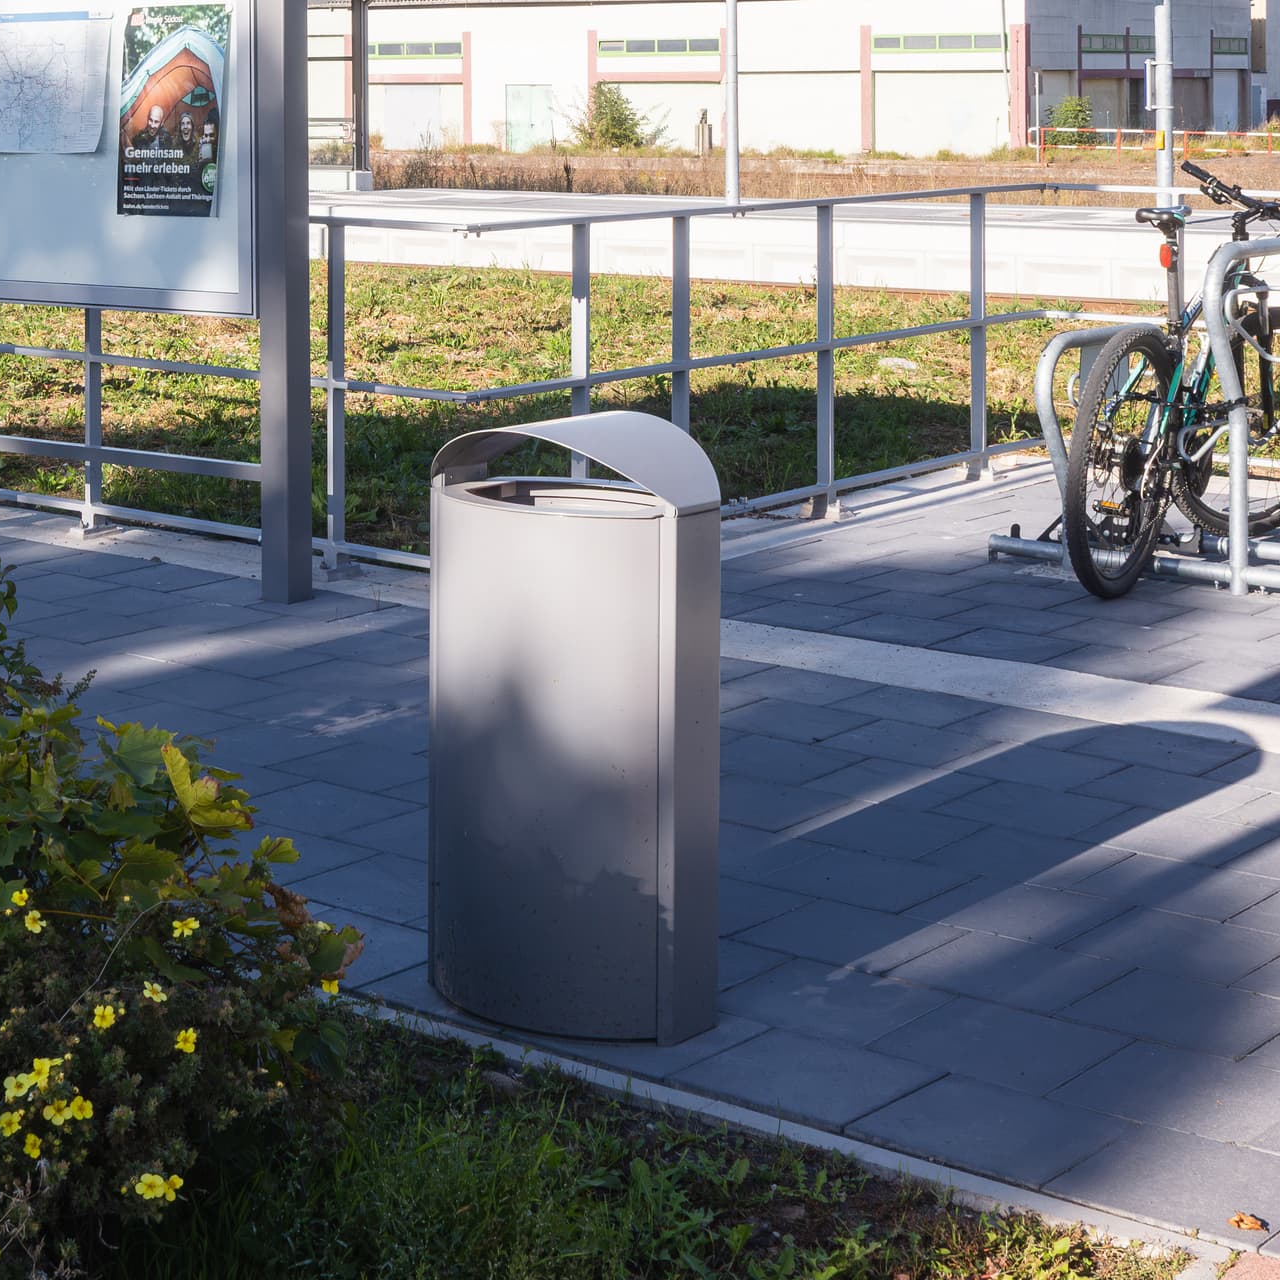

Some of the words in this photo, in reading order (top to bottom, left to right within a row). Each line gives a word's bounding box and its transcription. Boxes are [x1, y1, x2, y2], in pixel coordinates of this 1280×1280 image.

[124, 146, 184, 159] Gemeinsam
[124, 162, 153, 174] mehr
[153, 162, 190, 174] erleben
